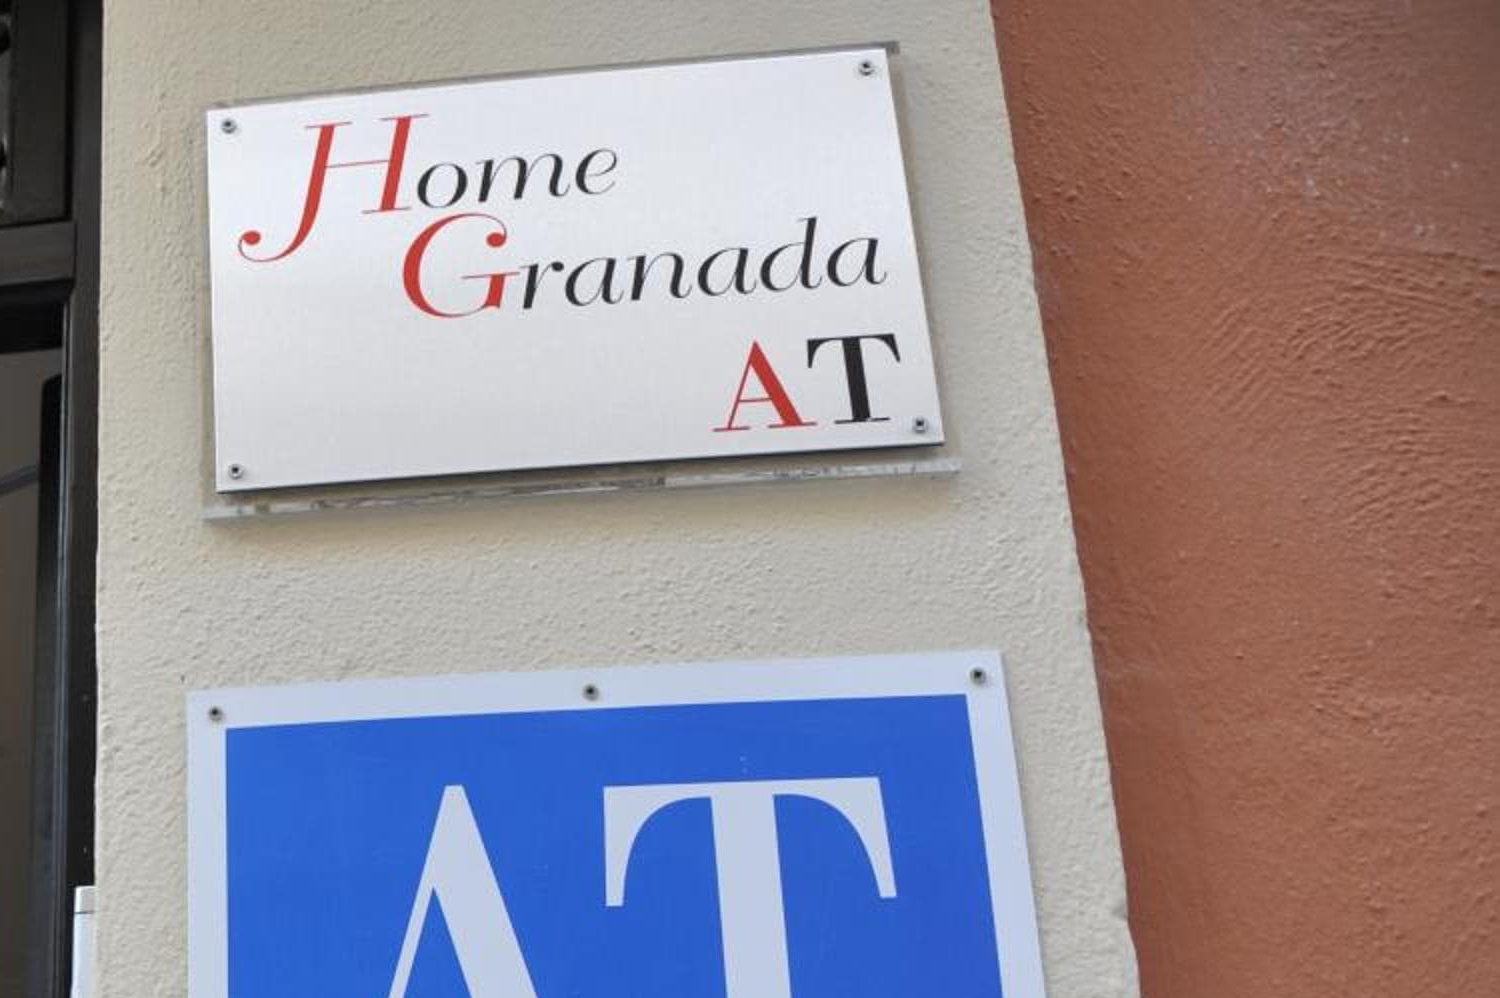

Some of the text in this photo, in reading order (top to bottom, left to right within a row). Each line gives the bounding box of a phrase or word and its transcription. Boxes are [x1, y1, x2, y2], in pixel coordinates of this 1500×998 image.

[238, 113, 619, 263] Home
[402, 212, 888, 319] Granada
[712, 332, 902, 432] AT
